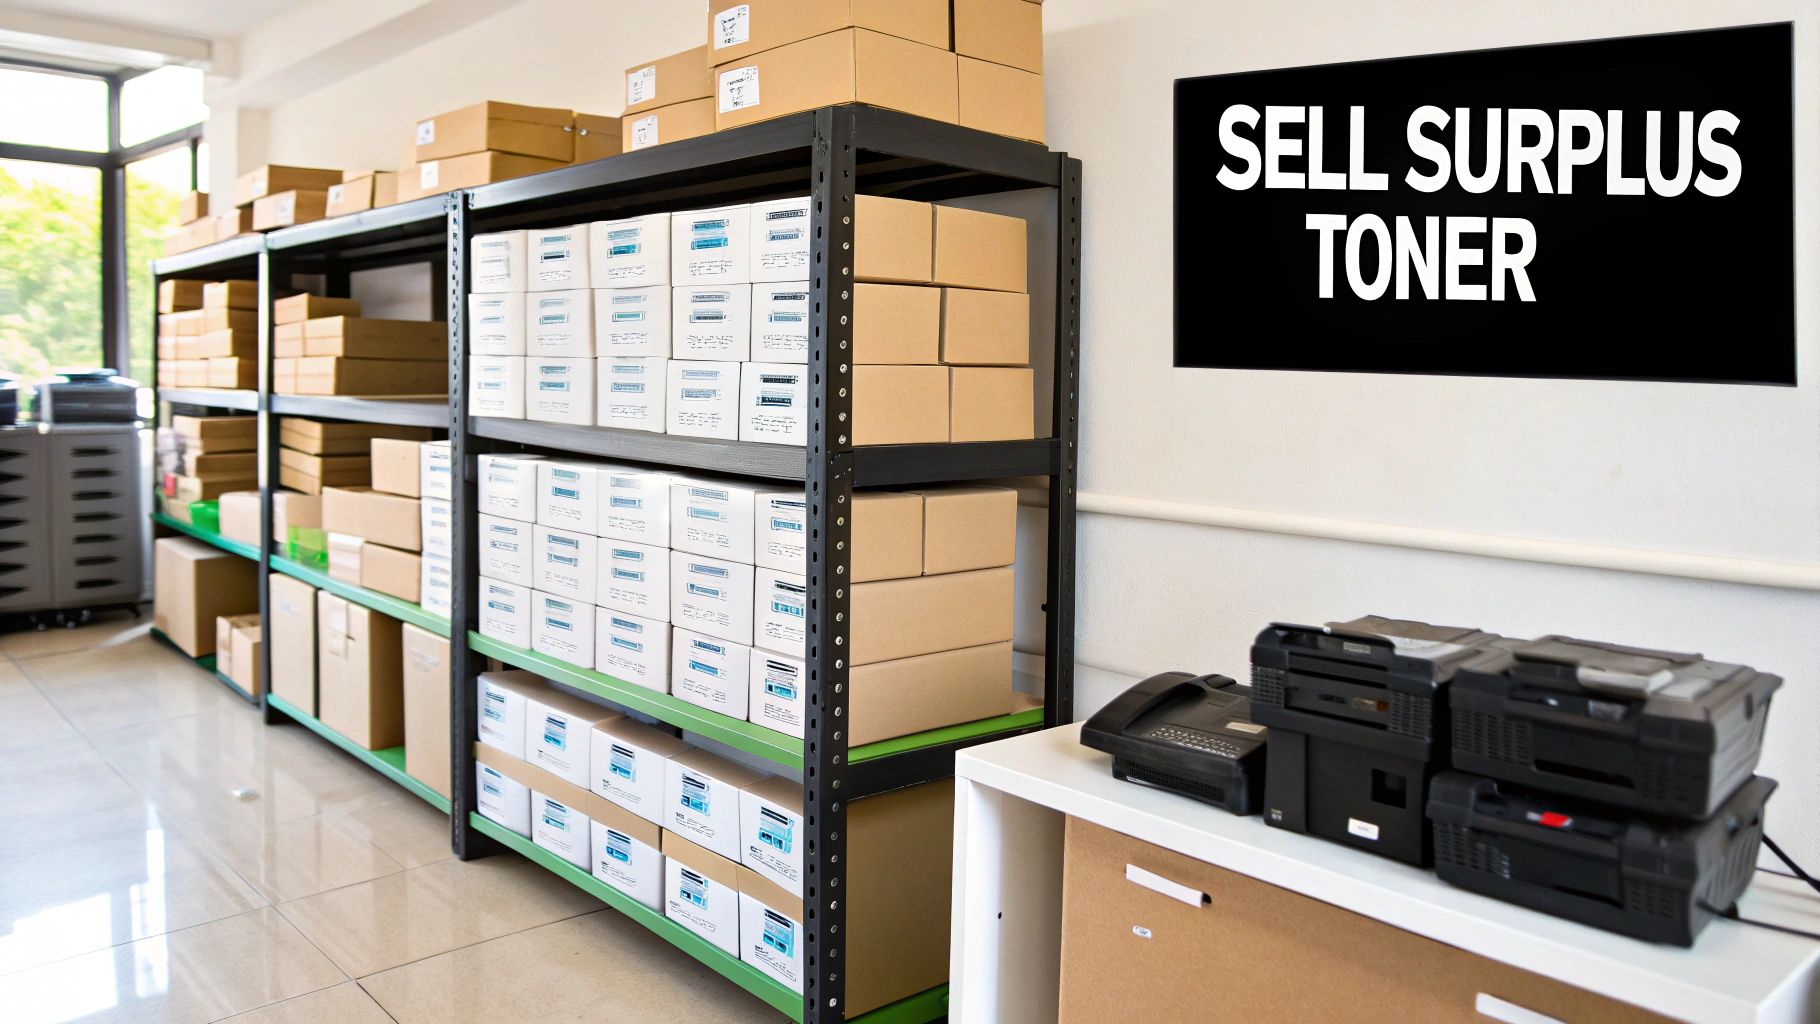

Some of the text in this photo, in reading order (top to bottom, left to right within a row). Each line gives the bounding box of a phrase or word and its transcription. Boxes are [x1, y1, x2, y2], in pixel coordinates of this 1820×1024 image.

[1216, 104, 1742, 197] SELL SURPLUS
[1306, 214, 1536, 301] TONER
